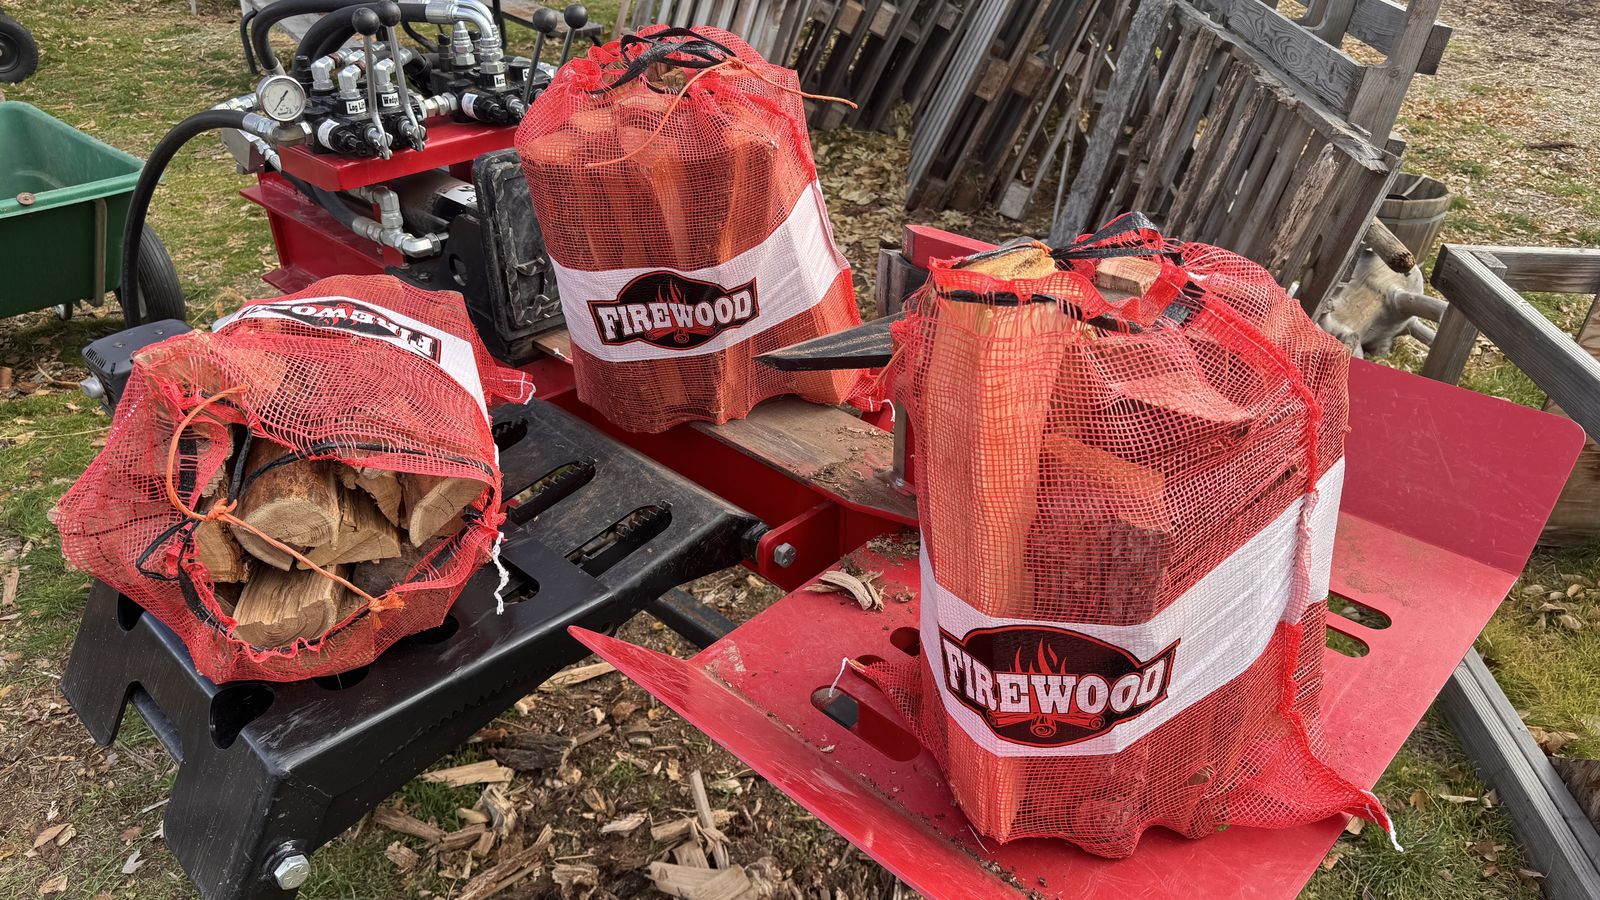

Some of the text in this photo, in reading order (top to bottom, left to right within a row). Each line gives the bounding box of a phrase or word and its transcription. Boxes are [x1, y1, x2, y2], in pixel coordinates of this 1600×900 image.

[348, 103, 358, 112] Log
[255, 304, 434, 358] FIREWO
[597, 289, 752, 341] FIREWOOD
[943, 637, 1166, 715] FIREWOOD
